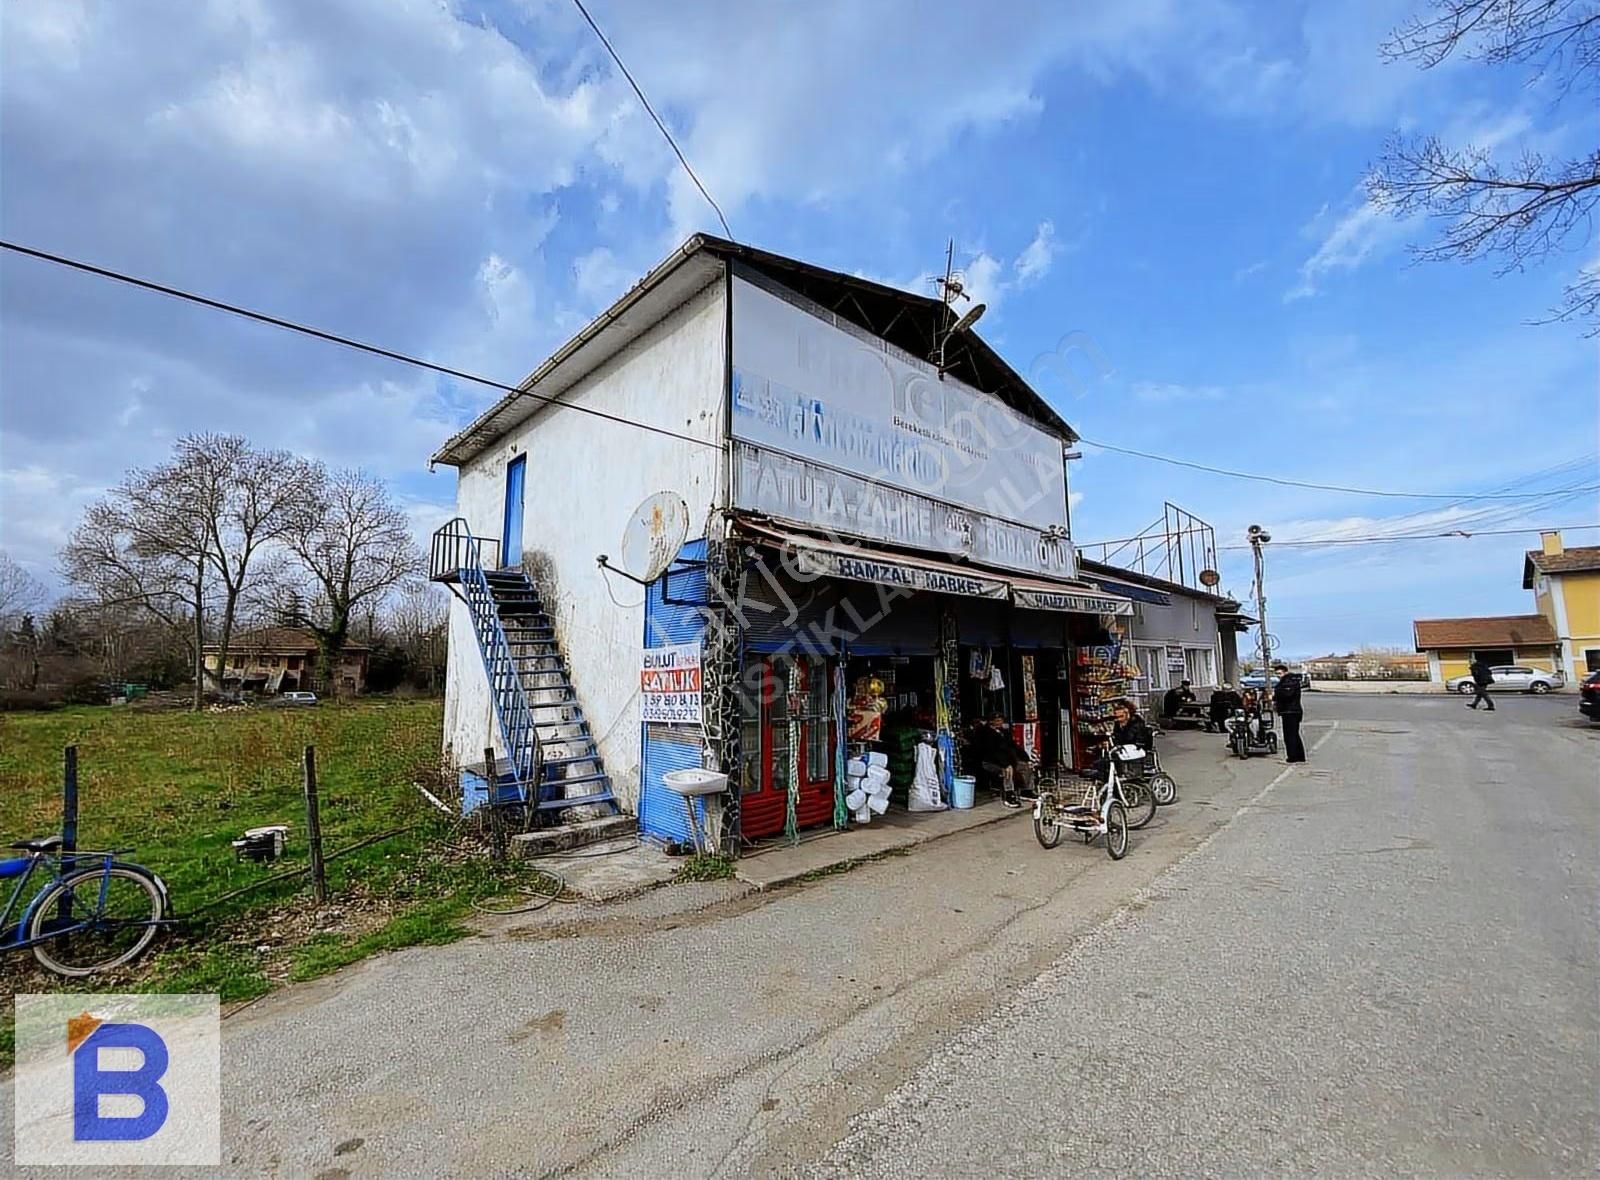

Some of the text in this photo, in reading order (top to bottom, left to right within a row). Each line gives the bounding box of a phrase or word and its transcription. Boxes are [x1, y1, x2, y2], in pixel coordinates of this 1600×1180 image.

[838, 557, 985, 595] HAMZALI MARKET
[1084, 598, 1118, 614] MARKET
[644, 651, 677, 668] BULUT
